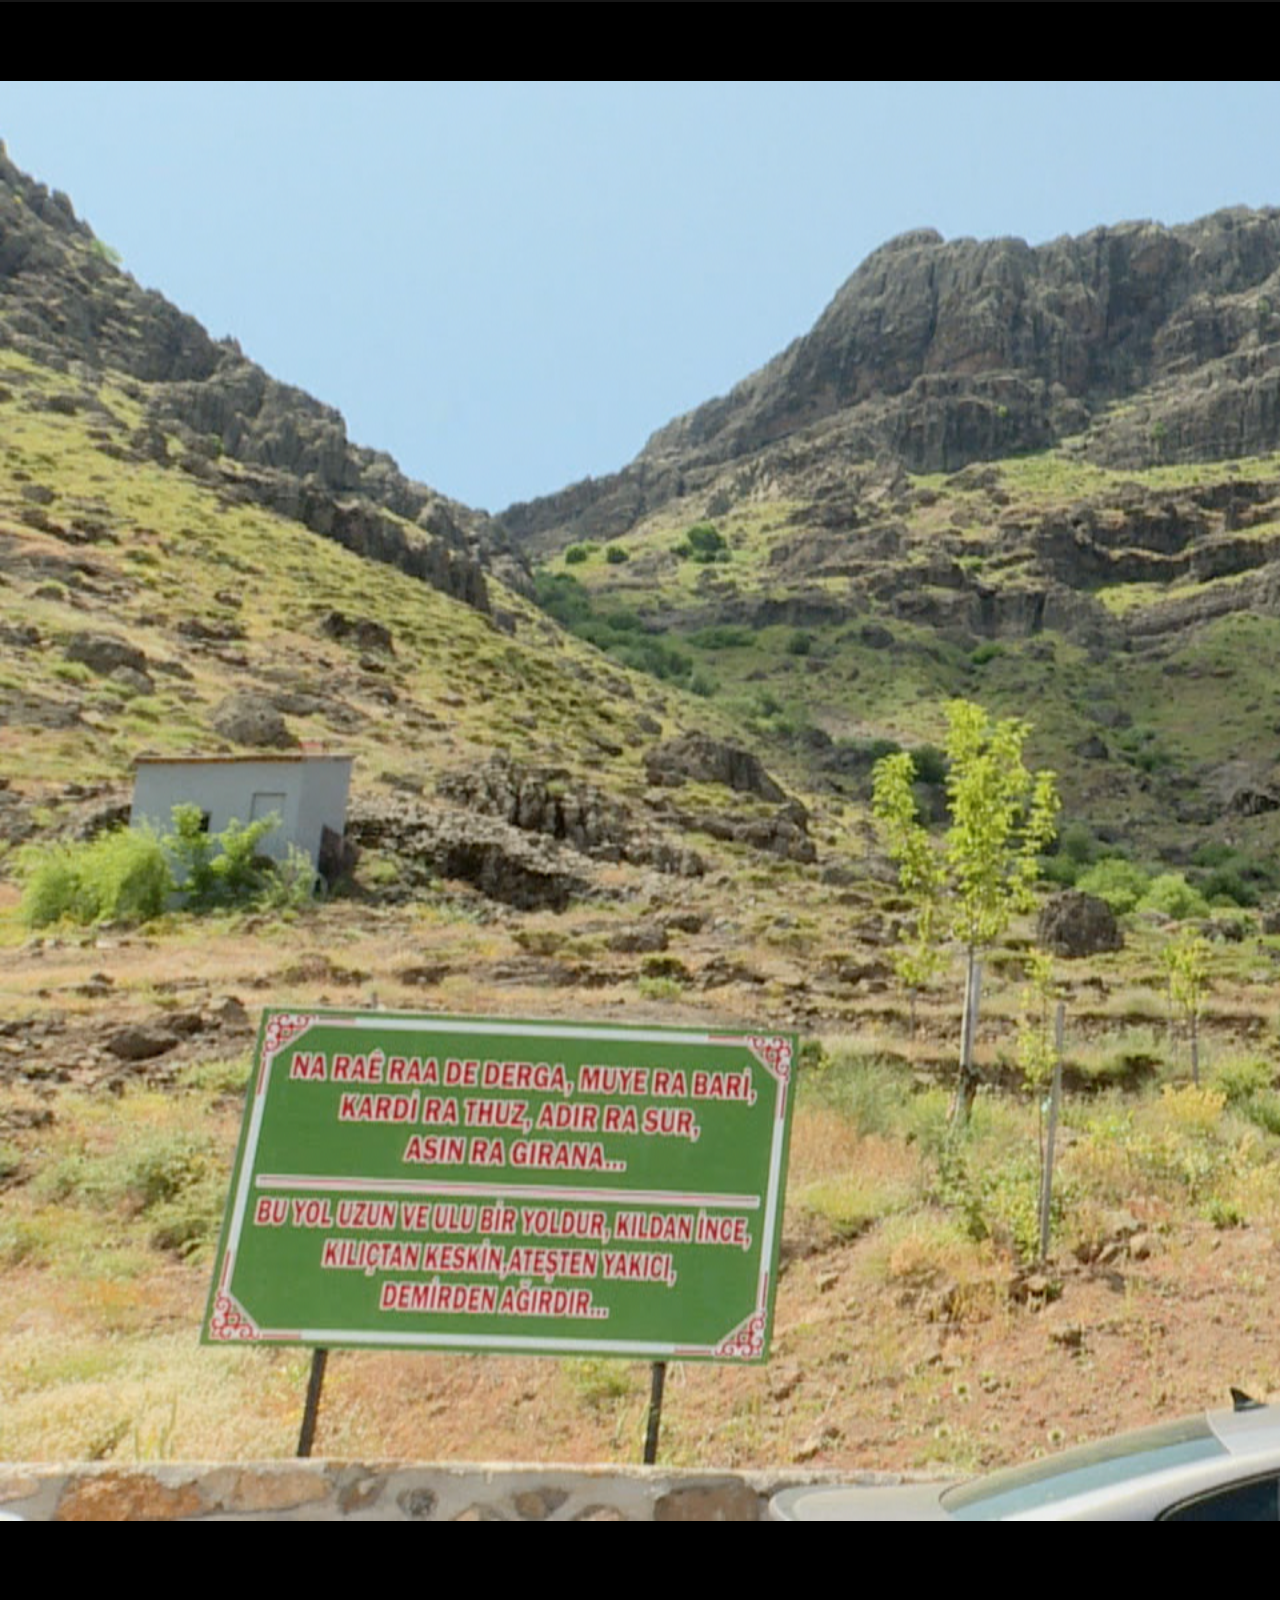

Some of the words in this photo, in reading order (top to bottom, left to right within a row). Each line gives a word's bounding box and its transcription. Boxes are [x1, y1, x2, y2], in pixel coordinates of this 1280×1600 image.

[291, 1052, 325, 1080] NA
[332, 1048, 384, 1083] RAÊ
[387, 1057, 438, 1085] RAA
[444, 1059, 479, 1086] DE
[483, 1060, 573, 1097] DERGA,
[579, 1065, 650, 1095] MUYE
[652, 1068, 686, 1096] RA
[691, 1066, 757, 1106] BARİ,
[339, 1089, 420, 1123] KARDİ
[423, 1096, 458, 1125] RA
[464, 1098, 532, 1133] THUZ,
[536, 1102, 598, 1131] ADIR
[603, 1105, 638, 1134] RA
[642, 1107, 701, 1142] SUR,
[403, 1135, 467, 1164] ASIN
[469, 1138, 505, 1167] RA
[510, 1140, 626, 1171] GIRANA...
[254, 1196, 289, 1226] BU
[293, 1198, 332, 1228] YOL
[337, 1200, 397, 1229] UZUN
[401, 1203, 430, 1230] VE
[432, 1203, 476, 1232] ULU
[478, 1198, 517, 1233] BİR
[522, 1207, 611, 1244] YOLDUR,
[614, 1211, 693, 1242] KILDAN
[695, 1208, 751, 1251] İNCE,
[321, 1238, 421, 1276] KILIÇTAN
[603, 1252, 676, 1287] YAKICI,
[380, 1275, 498, 1313] DEMİRDEN
[499, 1280, 609, 1318] AĞIRDIR...
